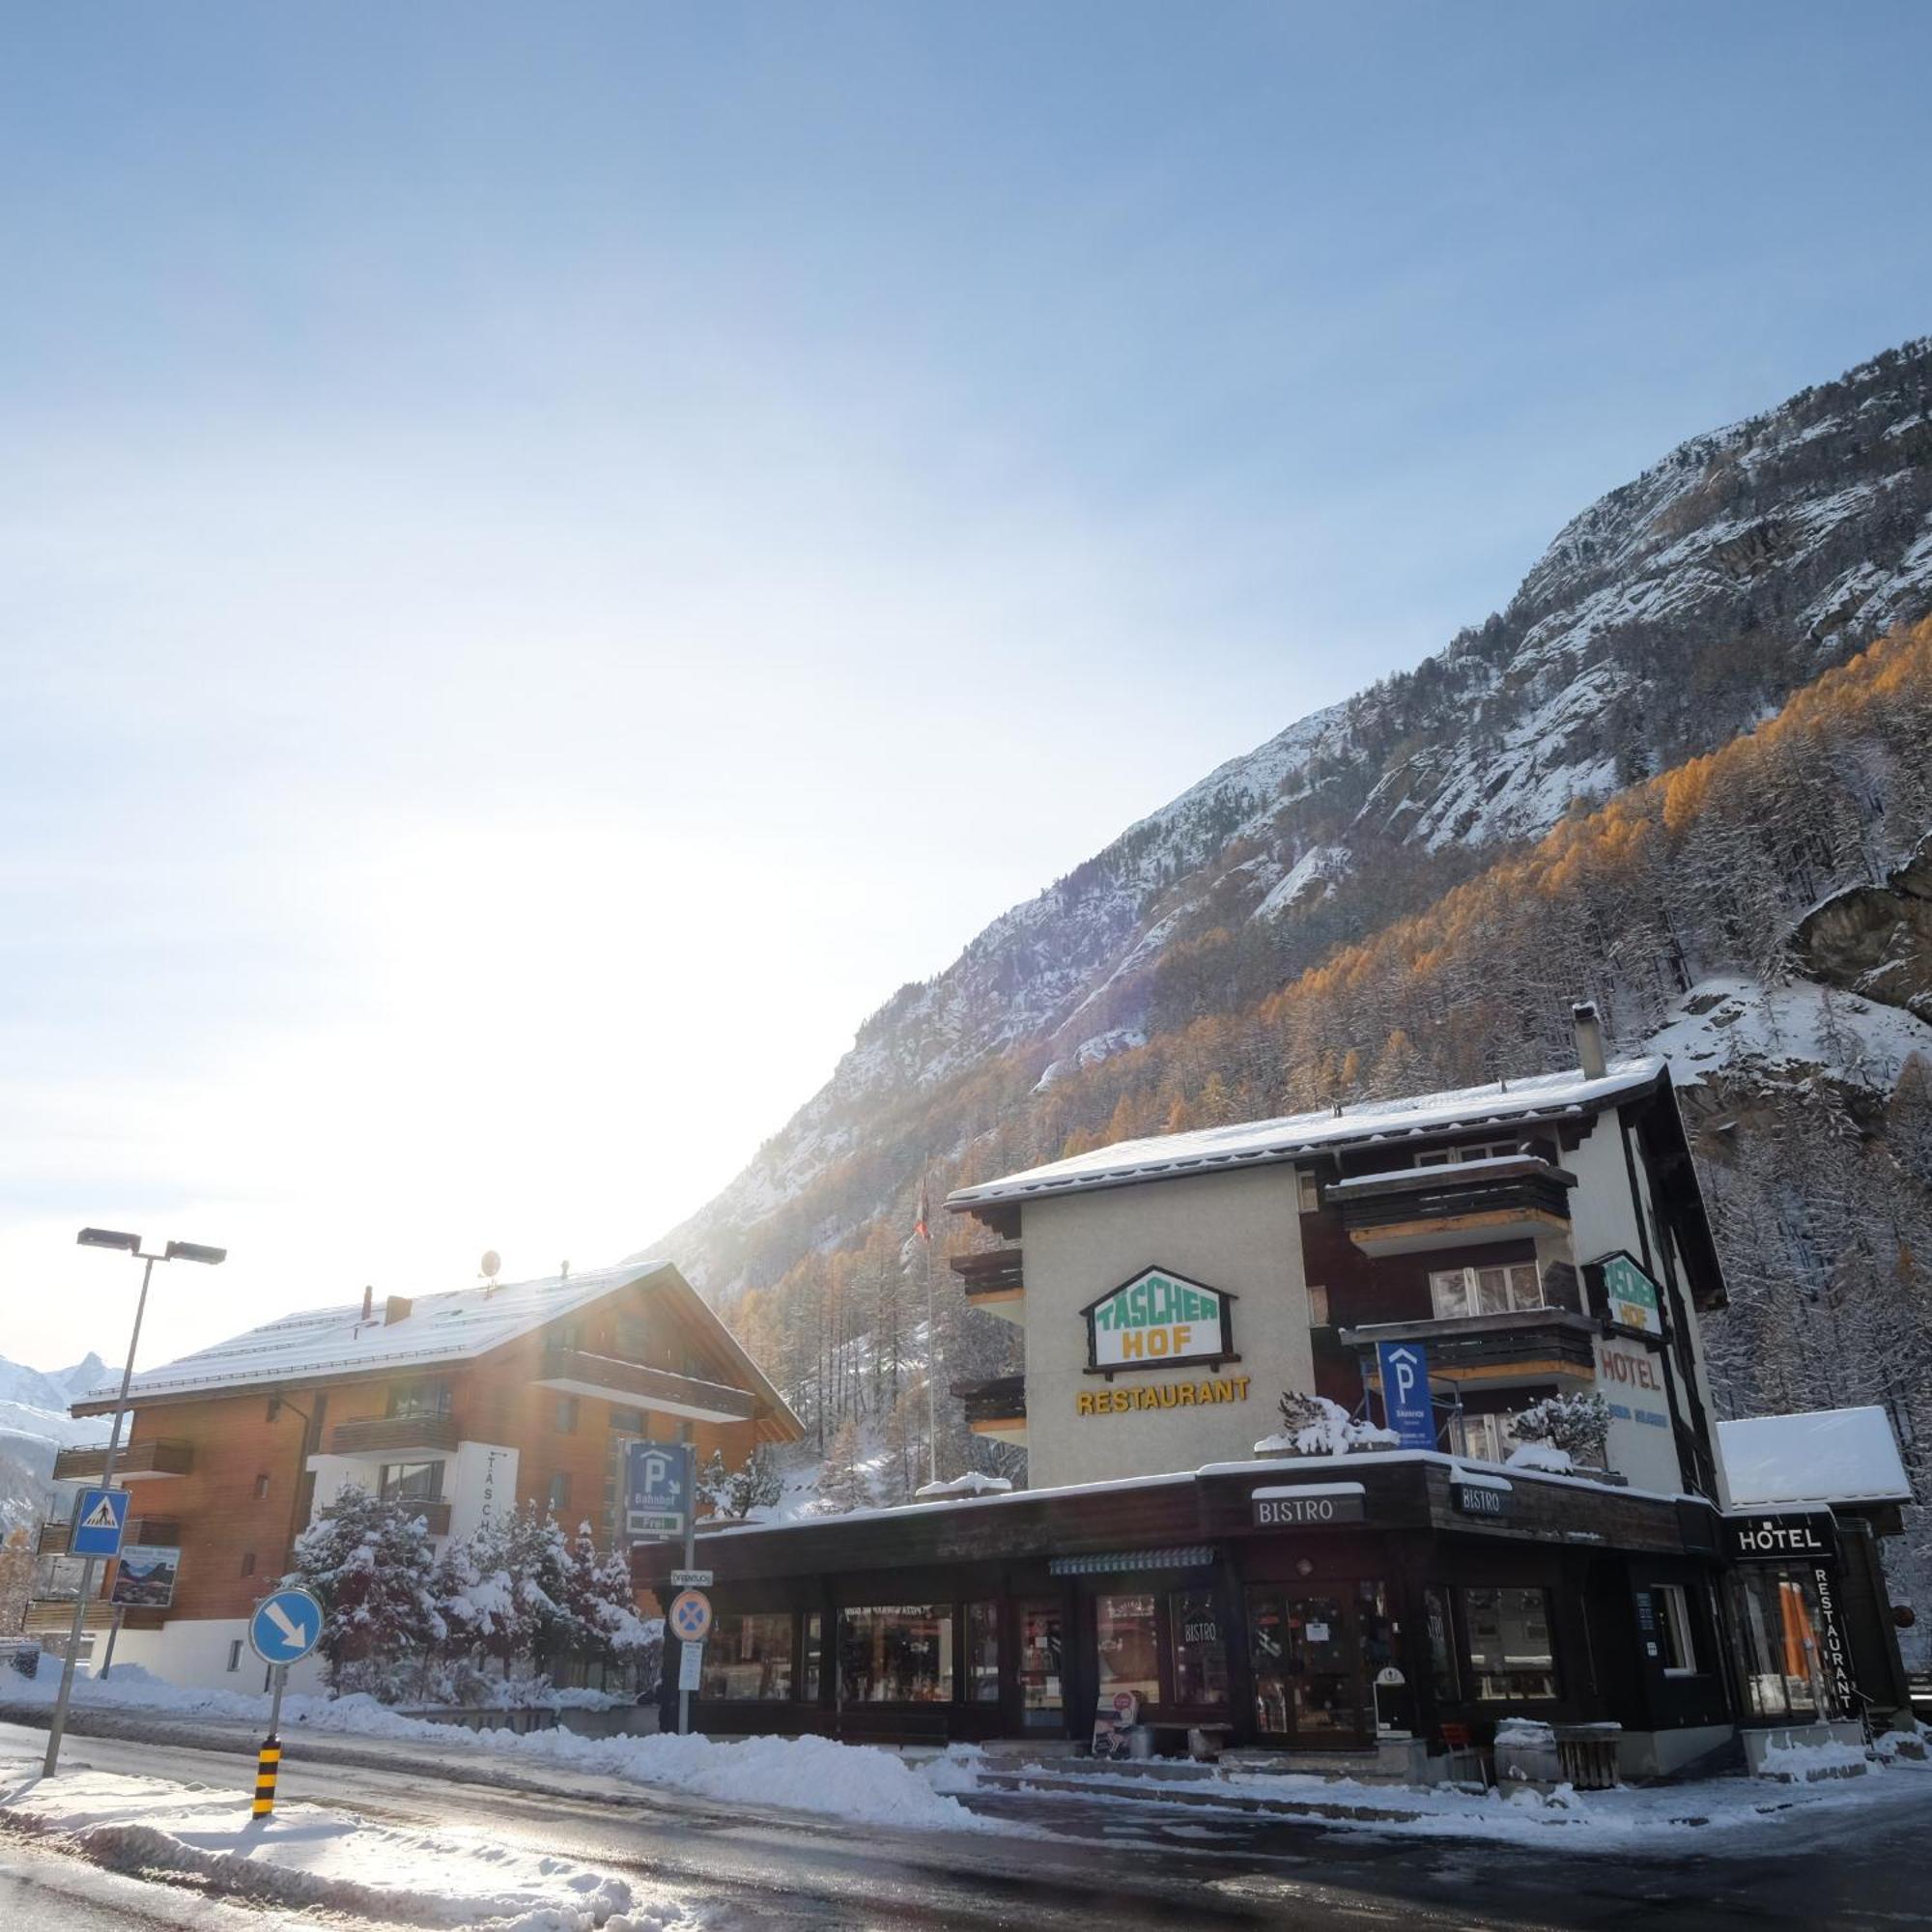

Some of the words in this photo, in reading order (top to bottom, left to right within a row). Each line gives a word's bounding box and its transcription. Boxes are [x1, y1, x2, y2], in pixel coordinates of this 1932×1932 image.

[1122, 1325, 1191, 1359] HOF
[1396, 1363, 1414, 1404] P
[1601, 1349, 1661, 1391] HOTEL
[1076, 1377, 1251, 1415] RESTAURANT
[645, 1458, 666, 1494] P
[1259, 1500, 1333, 1523] BISTRO
[1463, 1489, 1499, 1512] BISTRO
[1740, 1529, 1822, 1550] HOTEL
[1184, 1622, 1217, 1642] BISTRO
[1815, 1569, 1852, 1710] RESTAURANT
